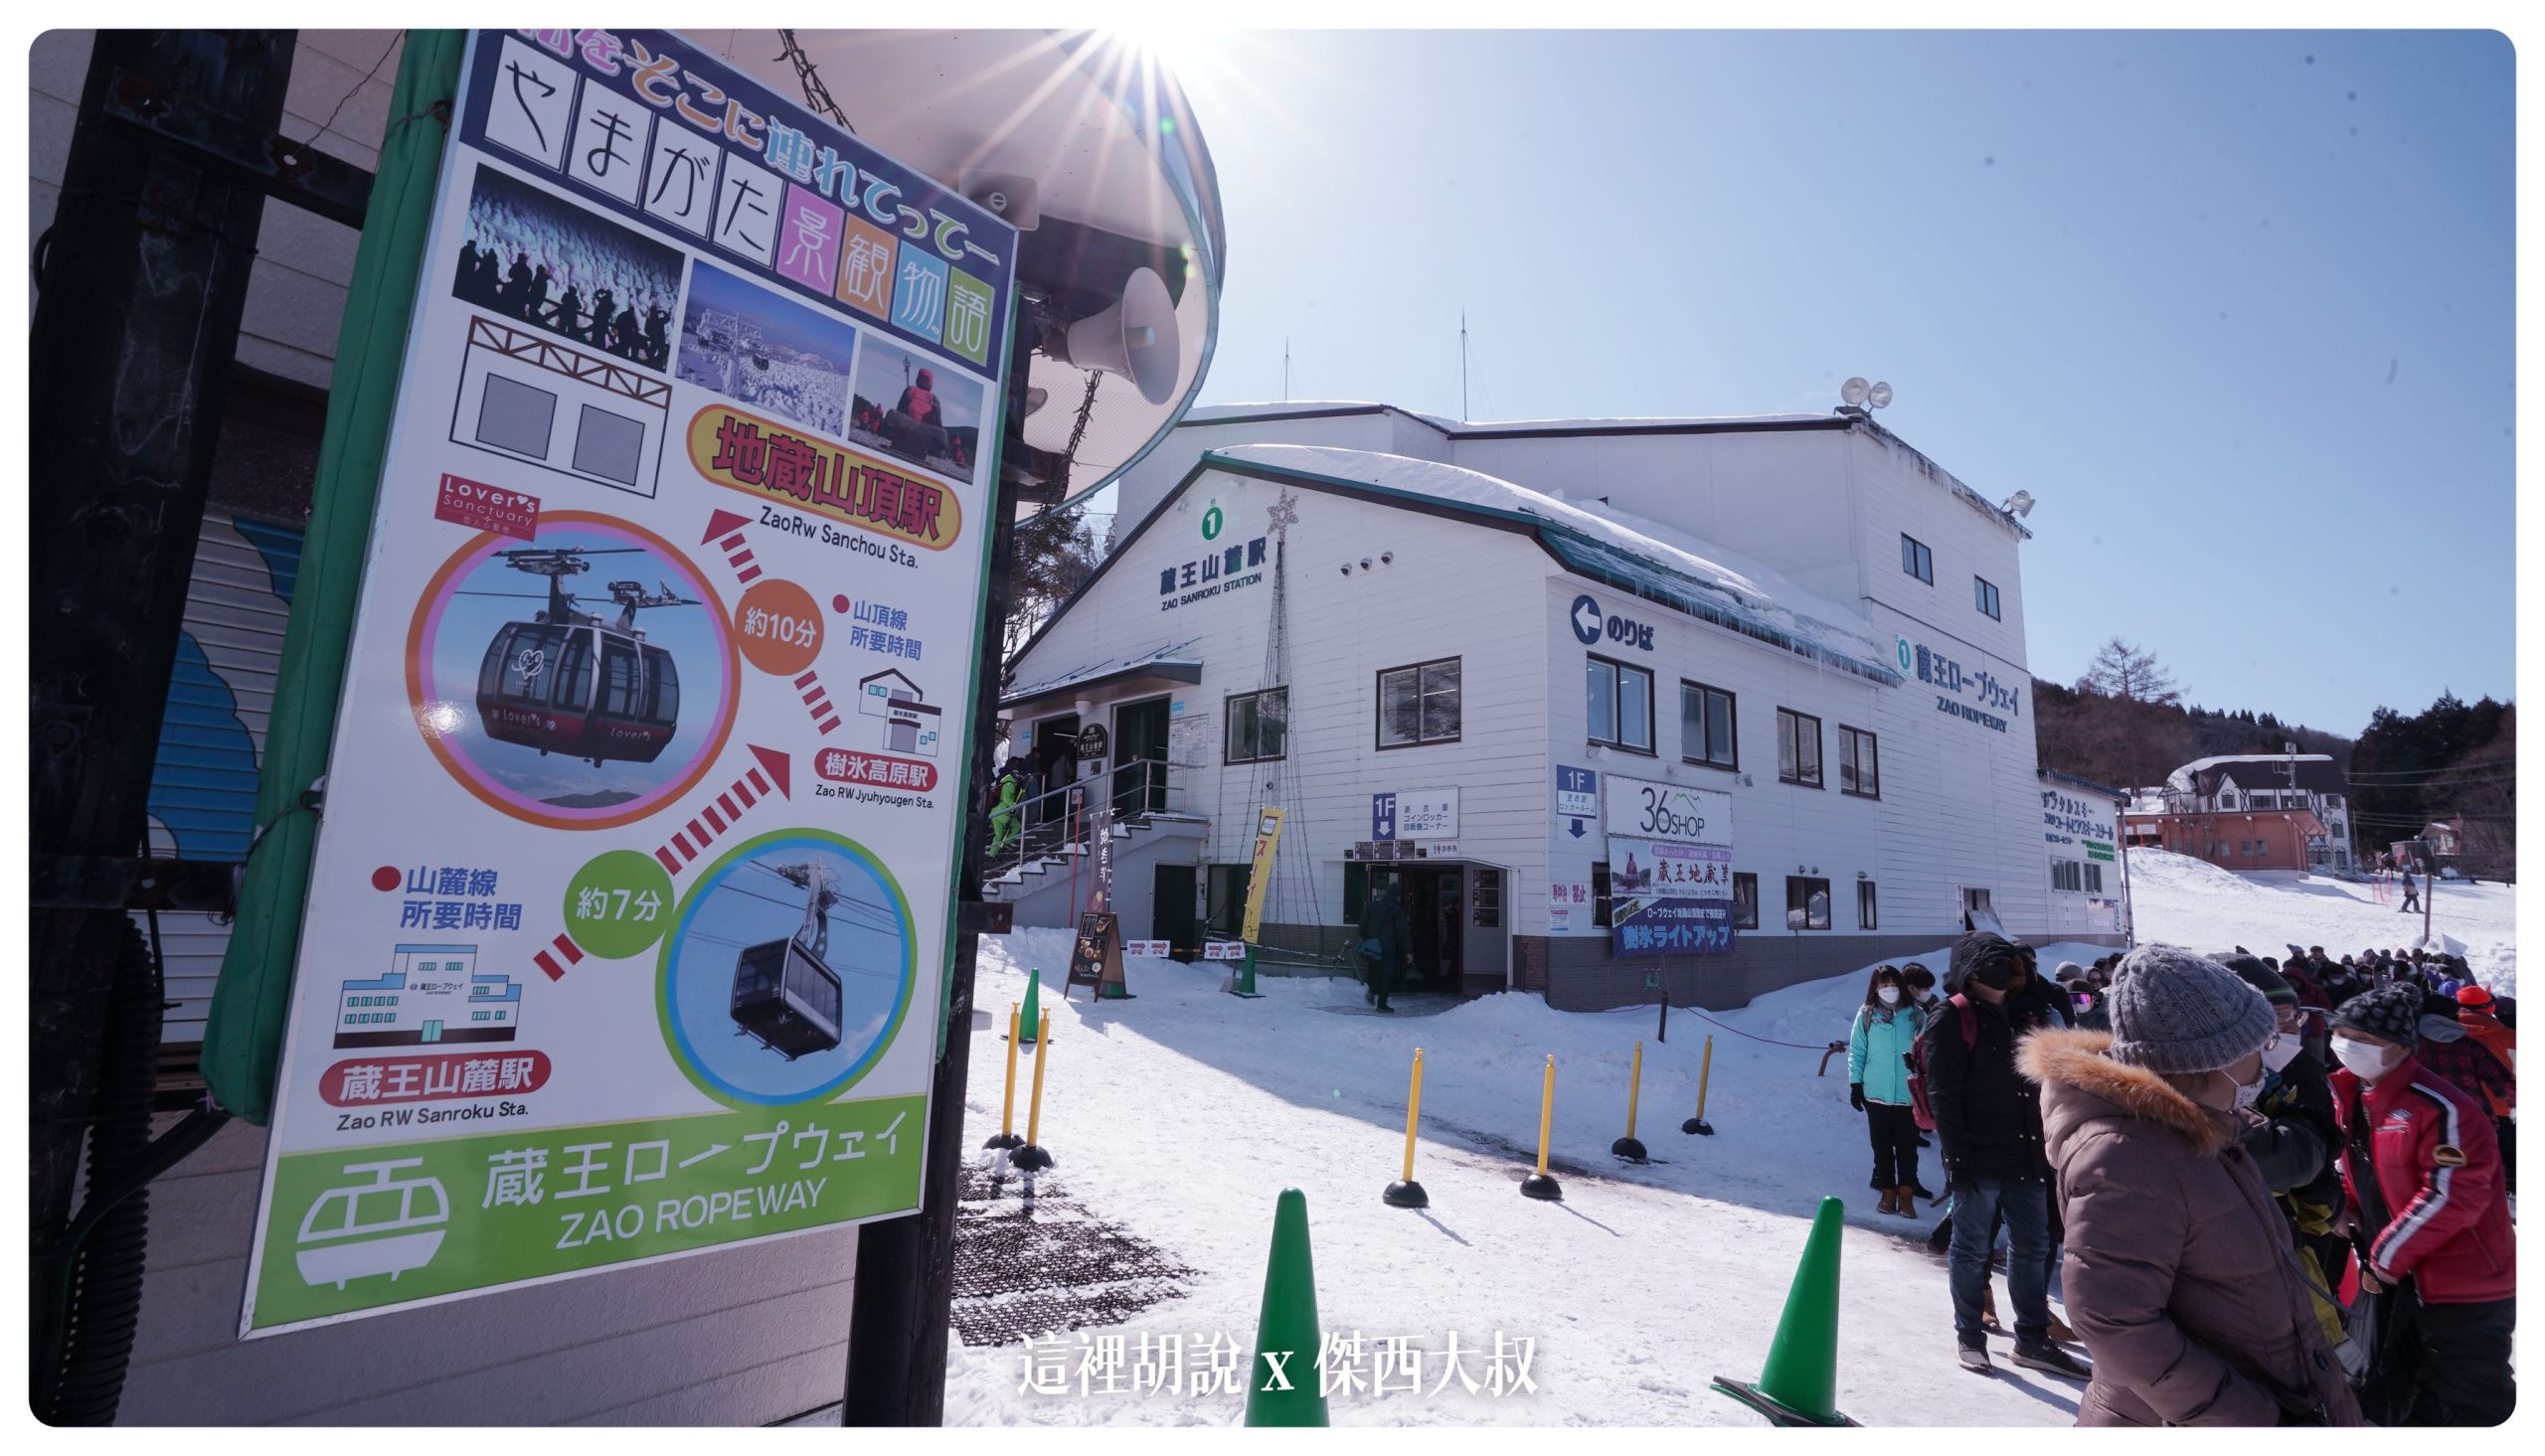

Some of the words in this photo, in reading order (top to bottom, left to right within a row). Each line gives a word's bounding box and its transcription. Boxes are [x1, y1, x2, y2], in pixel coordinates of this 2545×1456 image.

[504, 58, 989, 354] やまがた景観物語
[712, 414, 943, 542] 地蔵山頂駅
[442, 494, 533, 528] Sanctuary
[821, 524, 886, 560] Sanchou
[888, 544, 920, 569] Sta.
[1161, 598, 1178, 612] ZAO
[1180, 584, 1222, 605] SANROKU
[1223, 571, 1263, 593] STATION
[744, 605, 817, 649] 約10分
[853, 599, 909, 632] 山頂線
[1607, 614, 1655, 652] のりば
[849, 625, 923, 661] 所要時間
[1915, 643, 2019, 717] 蔵王ロープウェイ
[1937, 695, 1960, 717] ZAO
[1960, 704, 2008, 733] ROPEWAY
[825, 751, 929, 788] 樹氷高原駅
[1568, 770, 1586, 791] 1F
[814, 783, 836, 797] Zao
[837, 786, 855, 800] RW
[855, 789, 915, 808] Jyuhyougen
[916, 796, 934, 809] Sta.
[1375, 797, 1396, 818] 1F
[1559, 802, 1596, 813] ロッカールーム
[1404, 813, 1448, 823] コインロッカー
[1404, 822, 1448, 832] 自販機コーナー
[406, 866, 498, 896] 山麓線
[400, 899, 523, 931] 所要時間
[576, 887, 663, 922] 約7分
[1621, 923, 1731, 950] 樹氷ライトアップ
[338, 1056, 535, 1102] 蔵王山麓駅
[336, 1114, 376, 1132] Zao
[380, 1109, 415, 1128] RW
[417, 1103, 495, 1125] Sanroku
[498, 1100, 529, 1117] Sta.
[555, 1204, 645, 1250] ZAO
[654, 1177, 828, 1233] ROPEWAY
